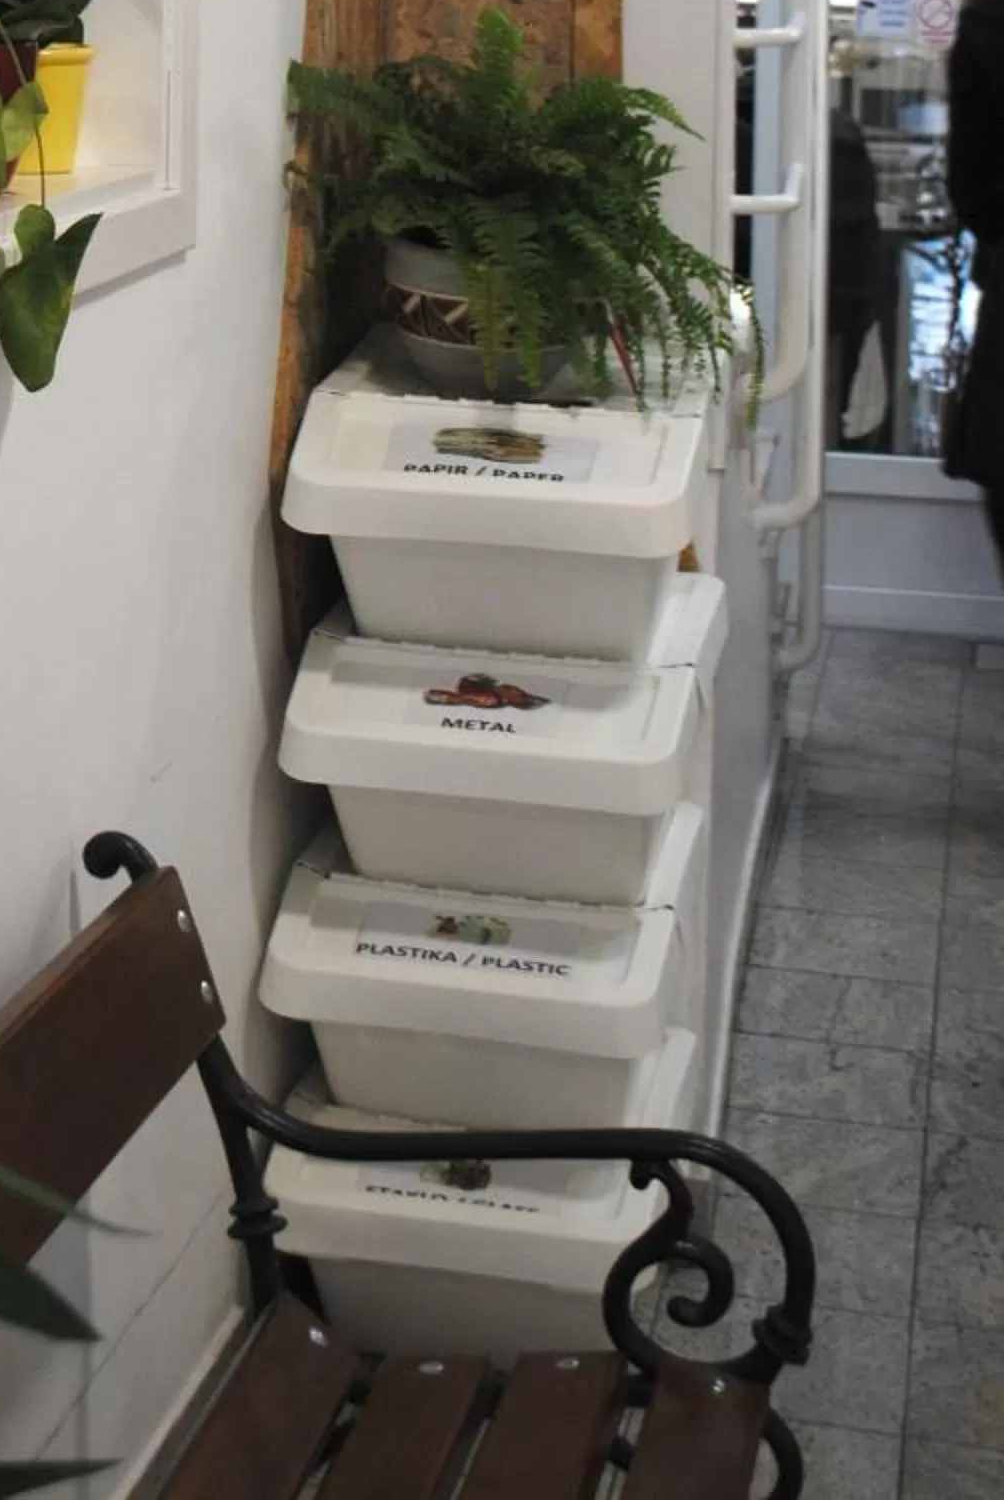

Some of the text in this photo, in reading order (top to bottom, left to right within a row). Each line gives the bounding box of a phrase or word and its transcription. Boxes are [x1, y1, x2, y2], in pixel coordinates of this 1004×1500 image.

[403, 463, 469, 476] PAPIR
[440, 717, 517, 734] METAL
[356, 942, 458, 964] PLASTIKA
[481, 956, 573, 977] PLASTIC
